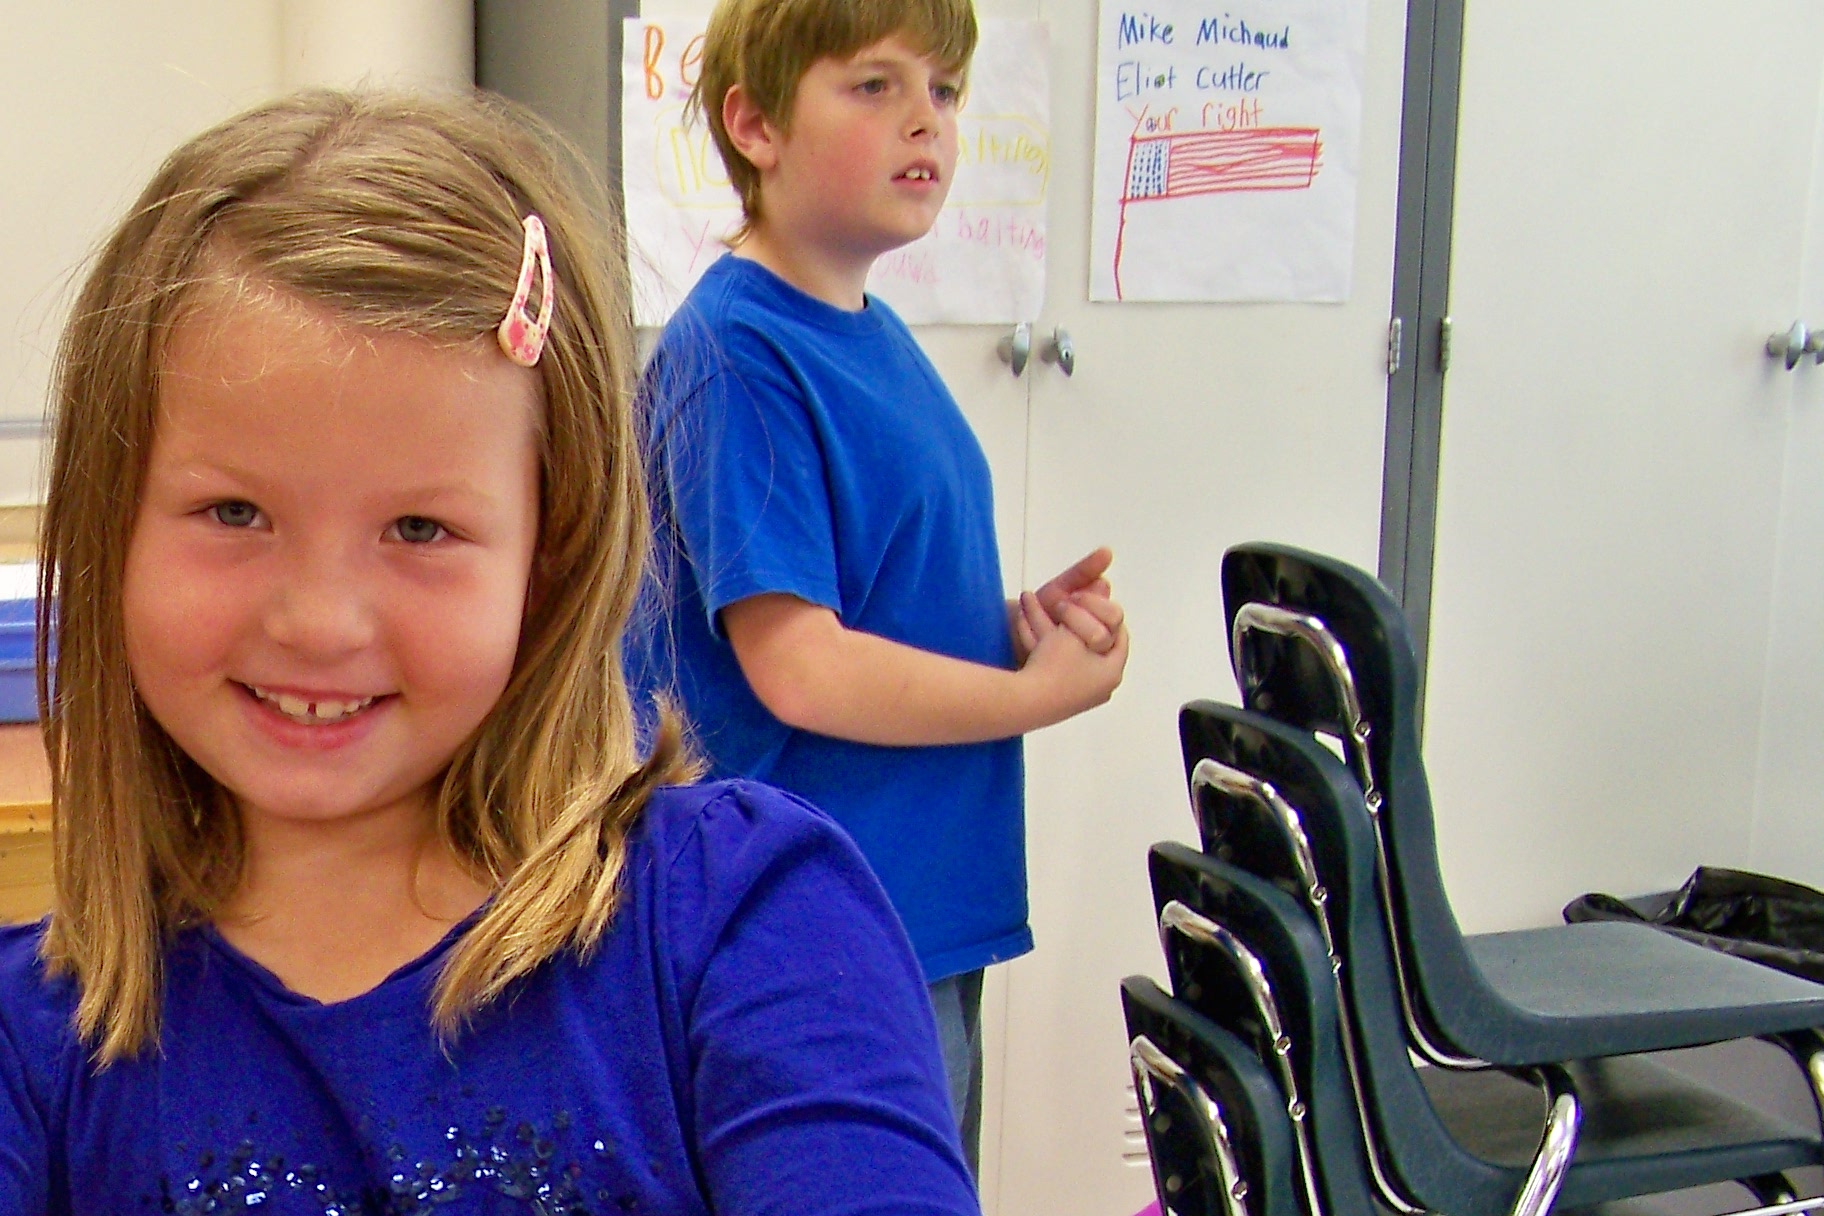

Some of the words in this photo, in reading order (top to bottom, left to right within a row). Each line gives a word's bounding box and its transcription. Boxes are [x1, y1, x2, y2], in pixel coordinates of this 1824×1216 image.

[1119, 13, 1174, 49] Mike
[1196, 14, 1289, 49] Michaud
[1117, 62, 1177, 101] Eliot
[1202, 98, 1263, 131] right
